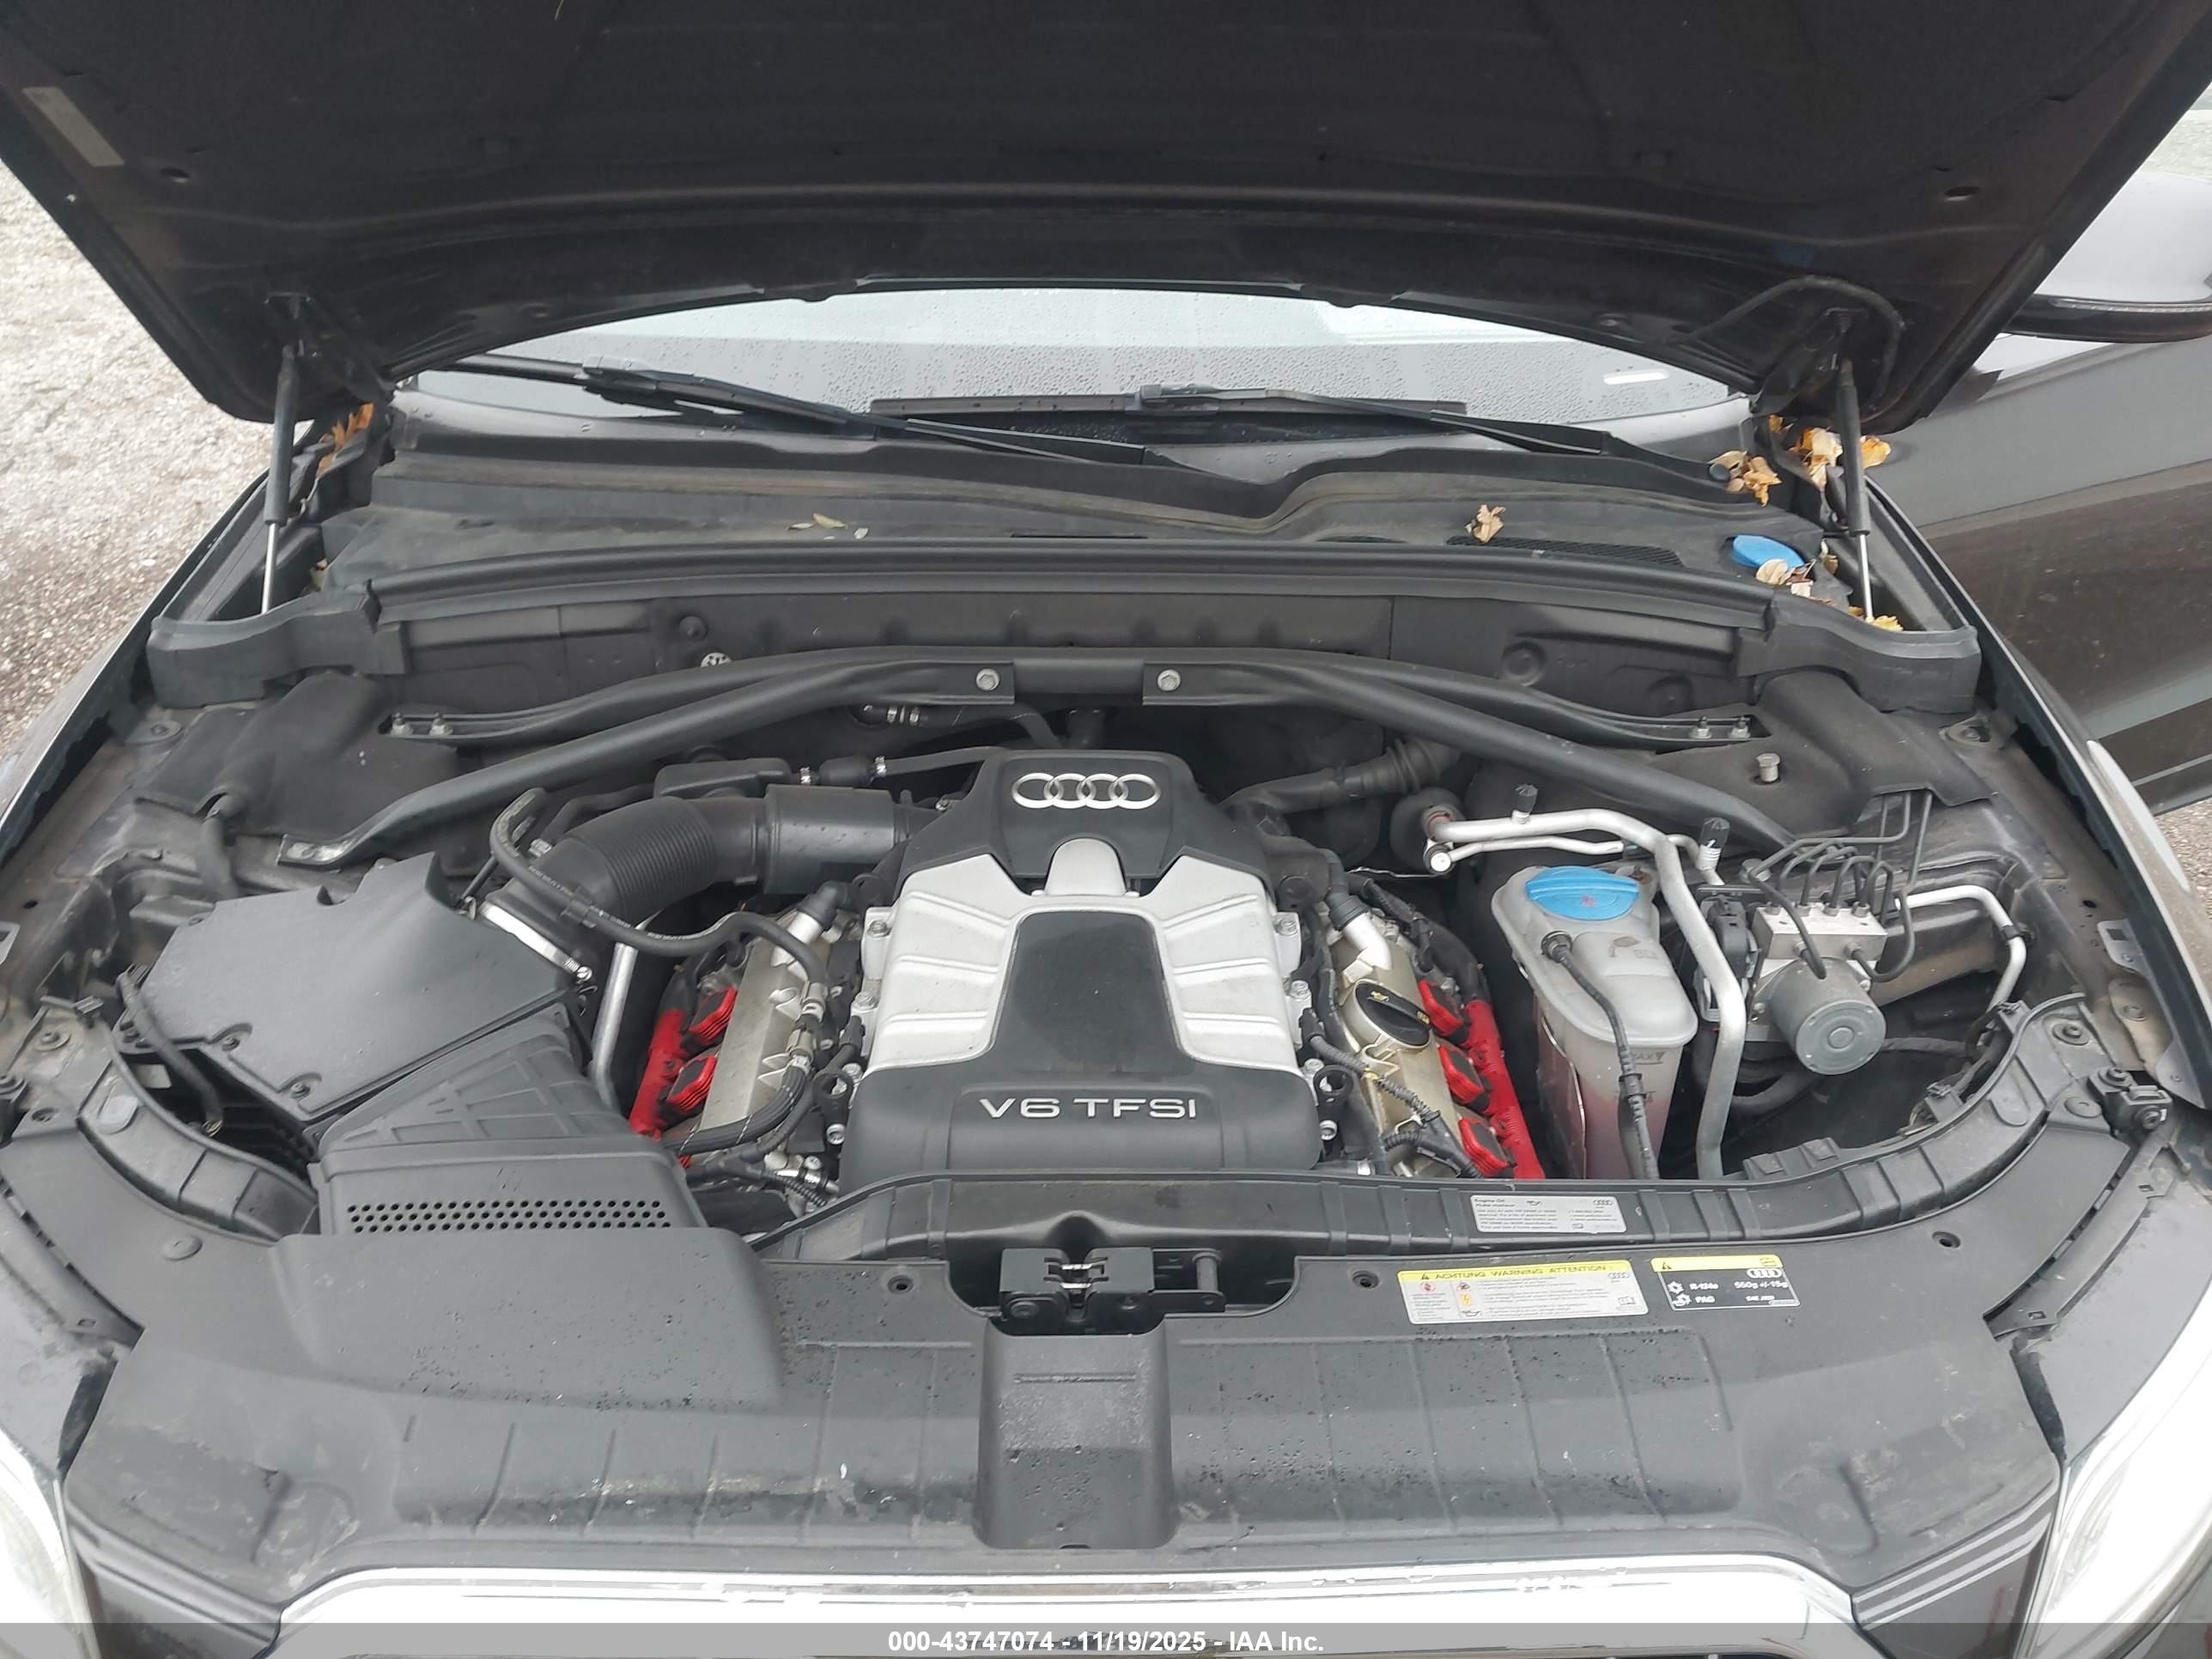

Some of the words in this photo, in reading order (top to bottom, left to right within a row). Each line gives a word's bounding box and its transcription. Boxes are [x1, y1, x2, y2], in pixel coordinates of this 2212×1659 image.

[979, 1097, 1060, 1118] V6
[1073, 1097, 1196, 1118] TFSI
[1492, 1268, 1544, 1277] WARNING
[1549, 1265, 1607, 1274] ATTENTION
